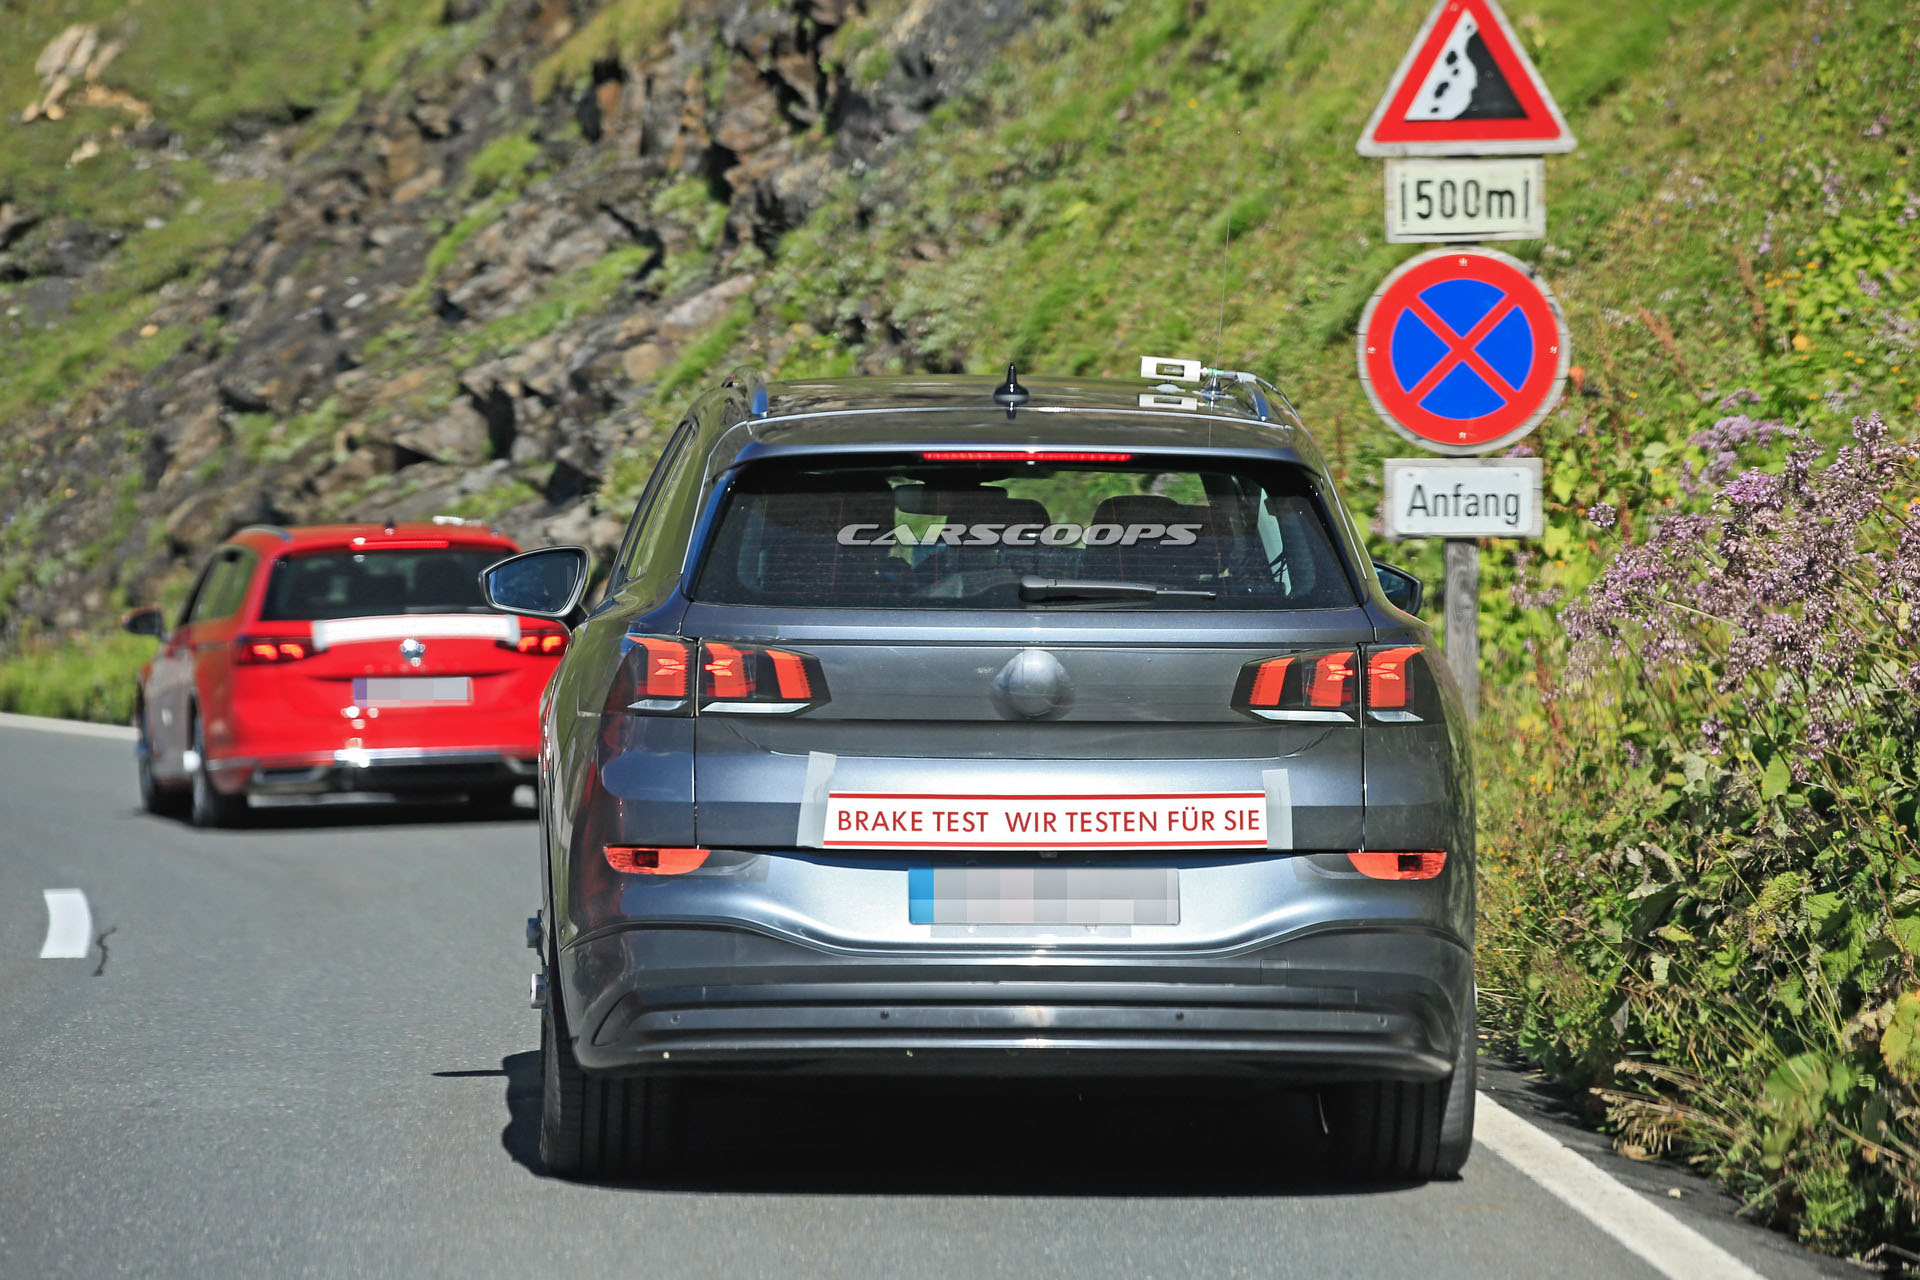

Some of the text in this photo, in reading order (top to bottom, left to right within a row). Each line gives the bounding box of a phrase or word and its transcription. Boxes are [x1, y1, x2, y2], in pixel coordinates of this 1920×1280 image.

[1407, 483, 1520, 525] Anfang
[838, 806, 1259, 832] BRAKE TEST WIR TESTEN FÜR SIE
